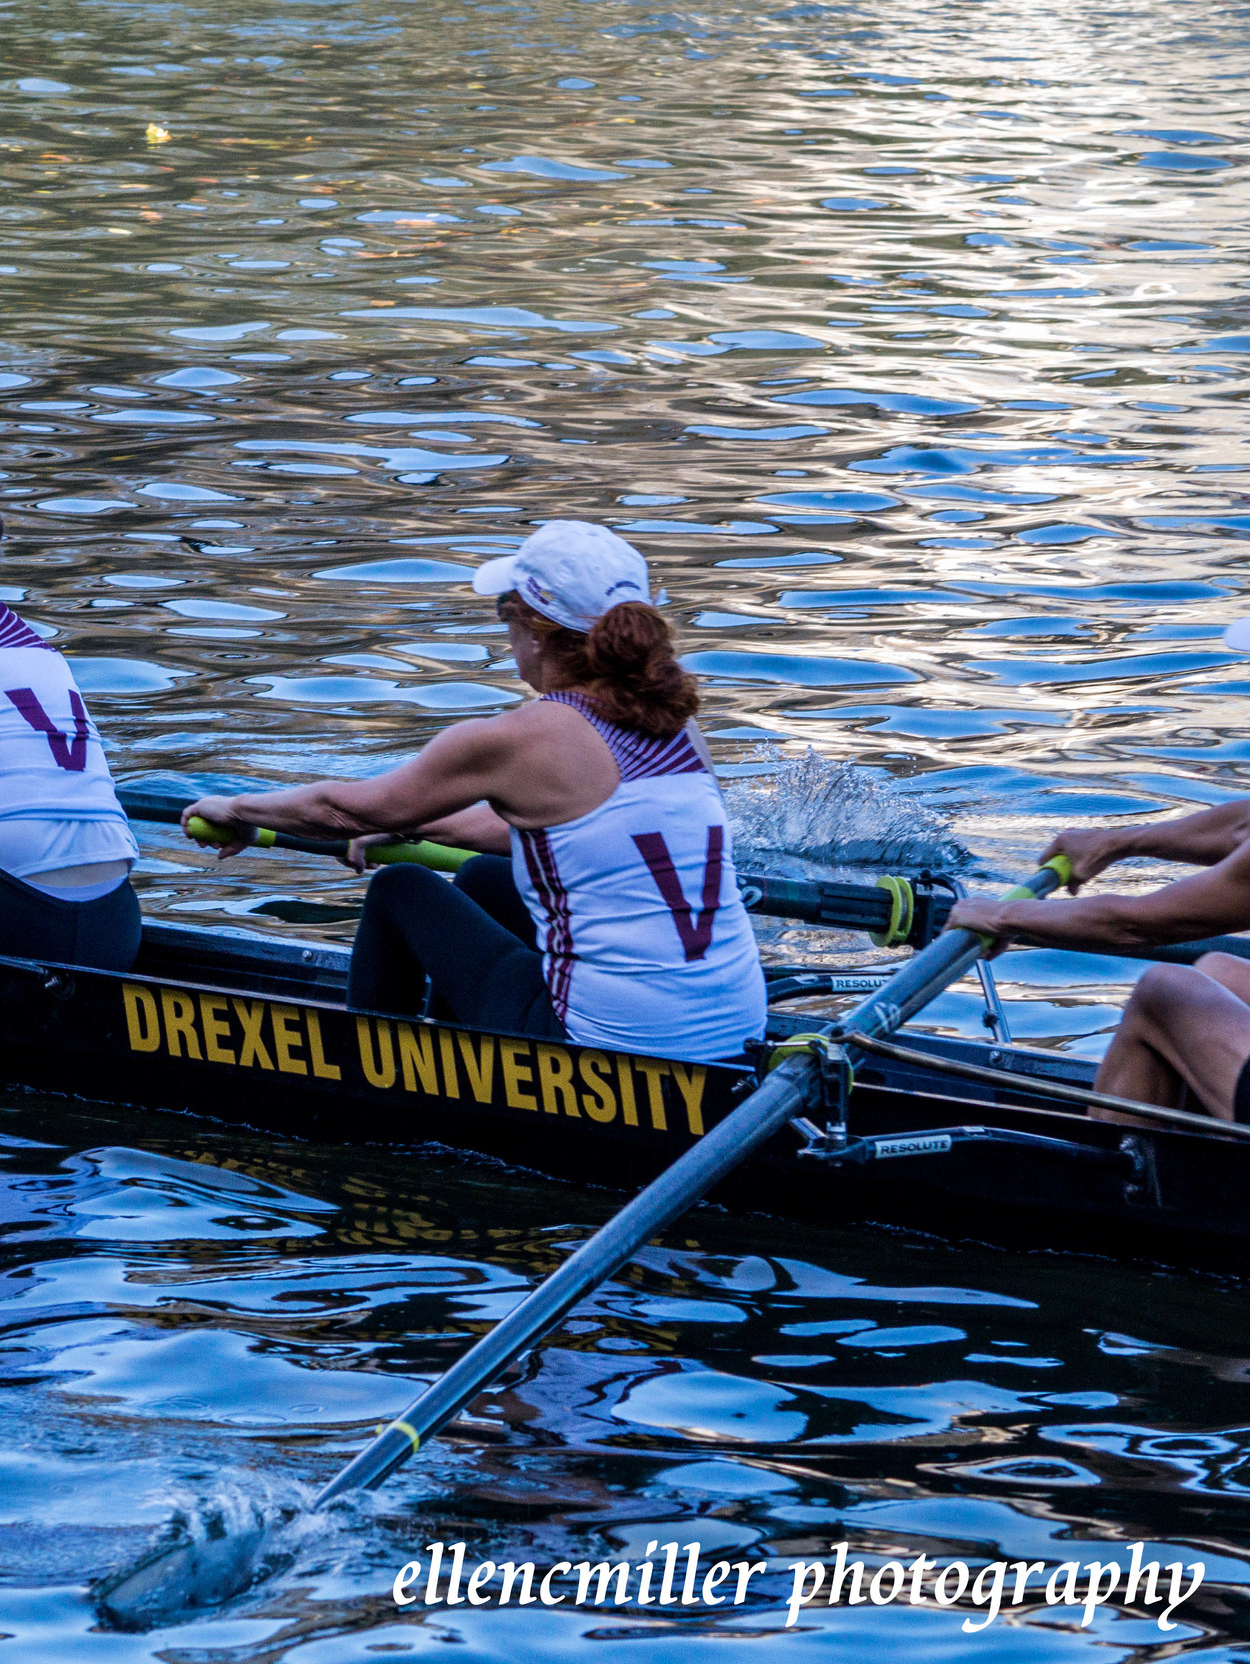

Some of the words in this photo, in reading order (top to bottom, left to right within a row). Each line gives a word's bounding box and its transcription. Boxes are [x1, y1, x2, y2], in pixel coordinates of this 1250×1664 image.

[5, 687, 90, 772] V
[631, 826, 724, 963] V
[836, 979, 889, 989] RESOLU
[122, 983, 342, 1081] DREXEL
[356, 1017, 708, 1136] UNIVERSITY
[880, 1139, 949, 1155] RESOLUTE
